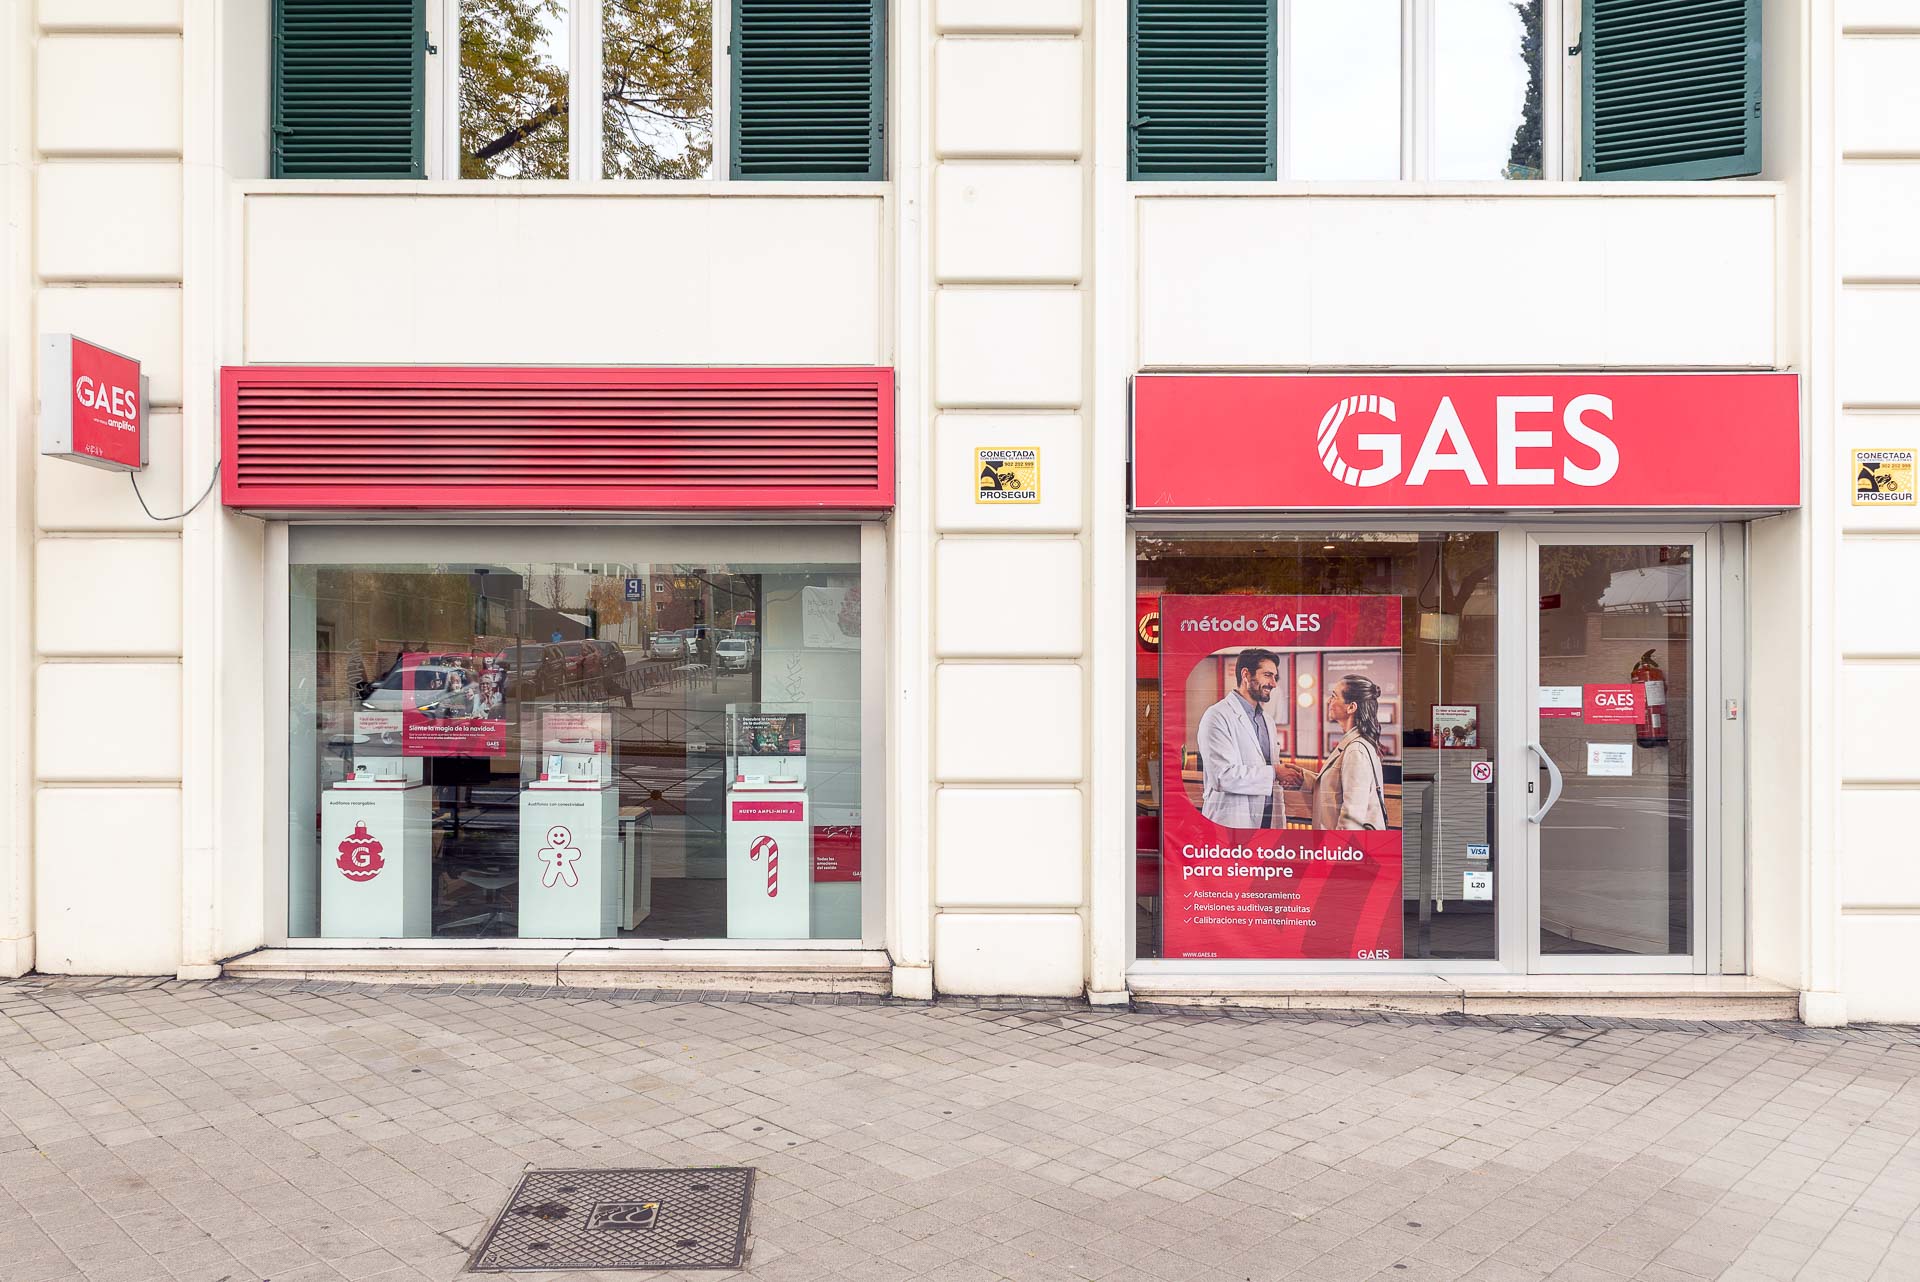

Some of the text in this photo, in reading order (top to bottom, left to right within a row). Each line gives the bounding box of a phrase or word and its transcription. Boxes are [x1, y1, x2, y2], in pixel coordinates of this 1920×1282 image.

[76, 375, 137, 420] GAES
[107, 418, 136, 432] amplifon
[1316, 393, 1620, 488] GAES
[980, 491, 1036, 499] PROSEGUR
[1857, 493, 1912, 501] PROSEGUR
[1180, 613, 1321, 632] método GAES
[1595, 693, 1634, 706] GAES
[351, 847, 371, 867] G
[1182, 844, 1363, 861] Cuidado todo incluido
[1182, 863, 1293, 881] para siempre
[1193, 890, 1233, 899] Asistencia
[1241, 891, 1301, 900] asesoramiento
[1193, 903, 1311, 914] Revisiones auditivas gratuitas
[1193, 916, 1247, 925] Calibraciones
[1255, 917, 1317, 926] mantenimiento
[1357, 950, 1390, 959] GAES
